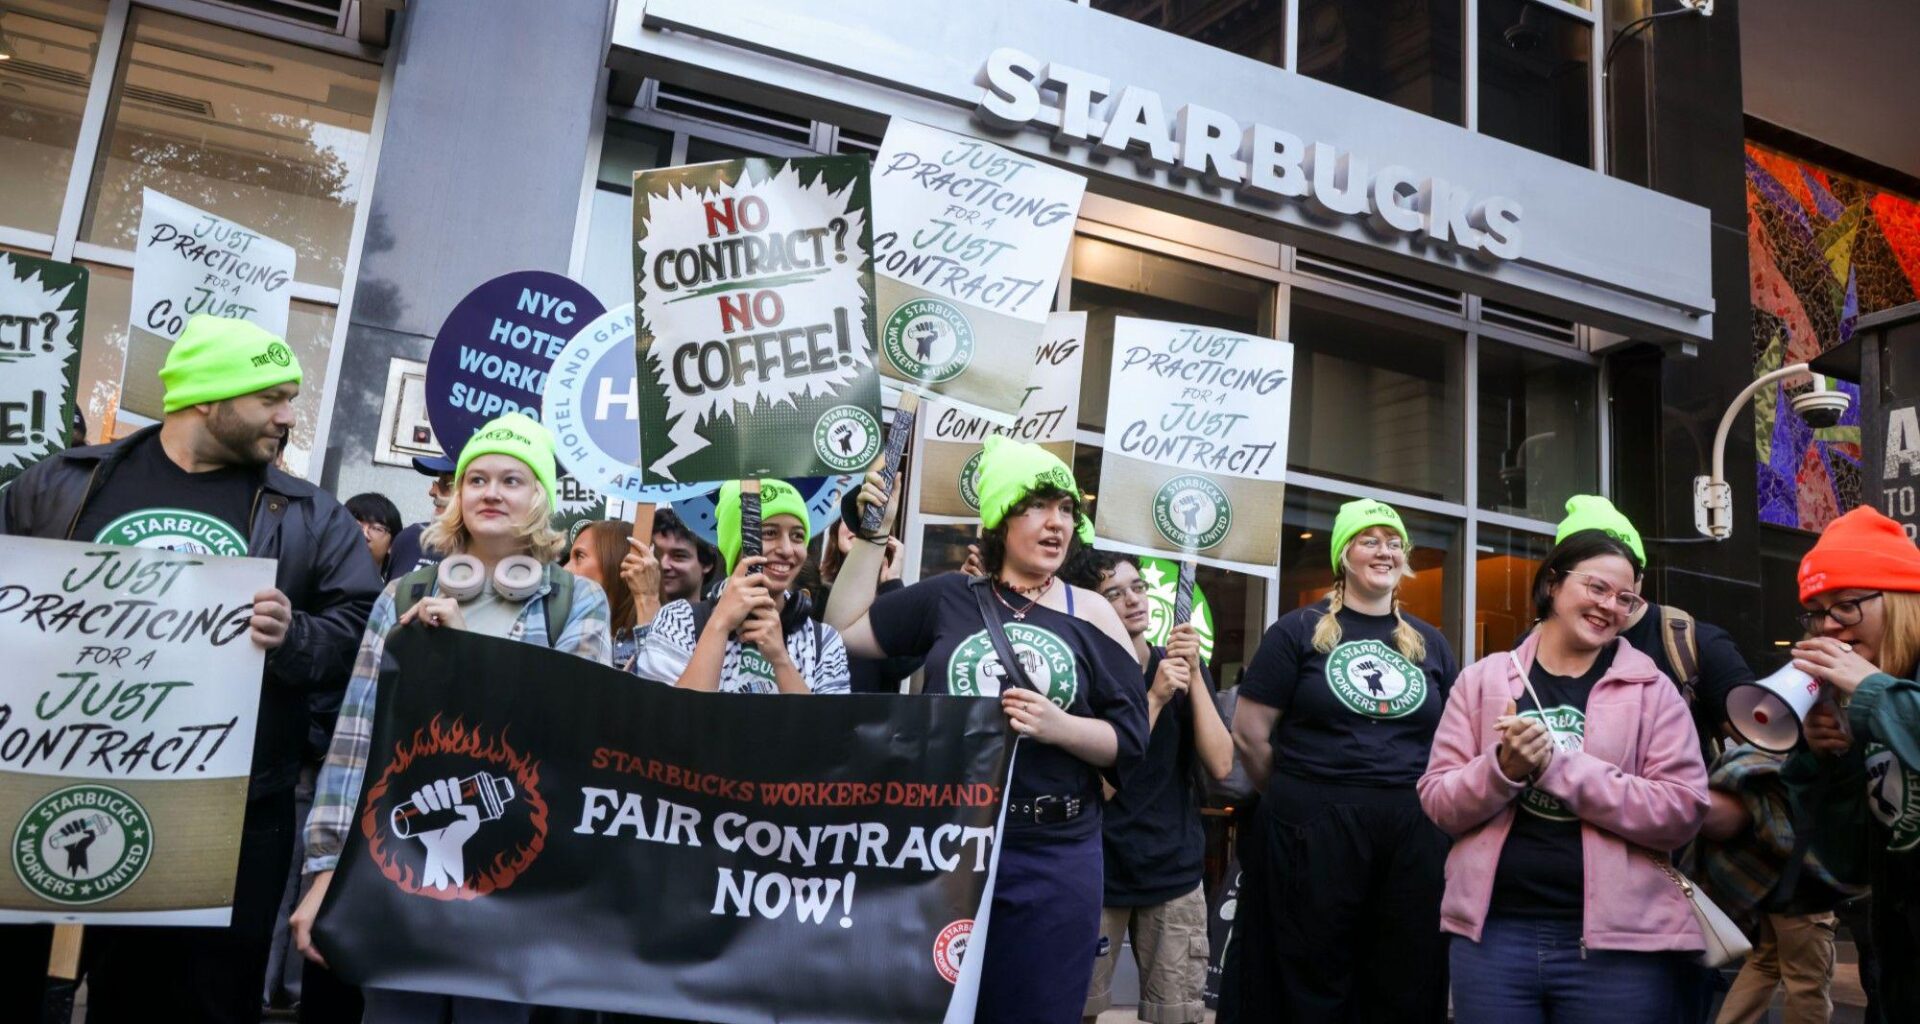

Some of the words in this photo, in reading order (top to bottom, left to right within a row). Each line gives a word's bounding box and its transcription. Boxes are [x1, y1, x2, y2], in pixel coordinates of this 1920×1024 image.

[940, 140, 1036, 183] JUST
[977, 46, 1525, 261] STARBUCKS
[882, 152, 1073, 228] PRACTICING
[193, 215, 260, 249] JUST
[703, 194, 770, 239] NO
[943, 203, 981, 226] FOR
[981, 217, 997, 231] A
[147, 222, 290, 293] PRACTICING
[653, 216, 849, 293] CONTRACT?
[912, 219, 1019, 267] JUST
[203, 273, 230, 291] FOR
[231, 284, 241, 297] A
[873, 231, 1045, 313] CONTRACT!
[184, 287, 258, 320] JUST
[516, 287, 577, 325] NYC
[716, 289, 785, 334] NO
[904, 303, 968, 336] STARBUCKS
[489, 318, 566, 361] HOTE
[672, 306, 852, 397] COFFEE!
[888, 327, 920, 373] WORKERS
[932, 349, 968, 377] UNITED
[1168, 328, 1250, 360] JUST
[458, 345, 550, 396] WORK
[559, 347, 591, 390] AND
[1121, 346, 1288, 395] PRACTICING
[448, 382, 540, 424] SUPPO
[1181, 387, 1213, 402] FOR
[1215, 393, 1228, 405] A
[555, 397, 589, 462] HOTEL
[822, 408, 872, 429] STARBUCKS
[1160, 402, 1250, 439] JUST
[818, 437, 849, 467] WORKERS
[857, 435, 877, 462] UNITED
[1120, 419, 1278, 475] CONTRACT!
[610, 472, 698, 494] AFL-CI
[813, 474, 853, 517] NCIL
[961, 477, 981, 506] WORKE
[1167, 478, 1224, 504] STARBUCKS
[1883, 485, 1916, 518] TO
[121, 517, 240, 557] STARBUCKS
[1156, 504, 1191, 543] WORKERS
[1200, 515, 1227, 544] UNITED
[62, 550, 204, 598] JUST
[0, 584, 253, 647] PRACTICING
[76, 646, 131, 672] FOR
[133, 649, 156, 671] A
[979, 628, 1069, 674] SRBUCKS
[1341, 644, 1408, 672] STARBUCKS
[36, 671, 194, 722] JUST
[1331, 667, 1377, 711] WORKERS
[1390, 678, 1421, 711] UNITED
[592, 747, 755, 801] STARBUCKS
[759, 782, 881, 807] WORKERS
[885, 782, 1001, 807] DEMAND:
[40, 791, 138, 827] STARBUCKS
[573, 786, 702, 847] FAIR
[713, 811, 995, 872] CONTRACT
[20, 838, 76, 896] WORKERS
[94, 844, 144, 891] UNITED
[710, 867, 857, 929] NOW!
[943, 923, 975, 940] STARB
